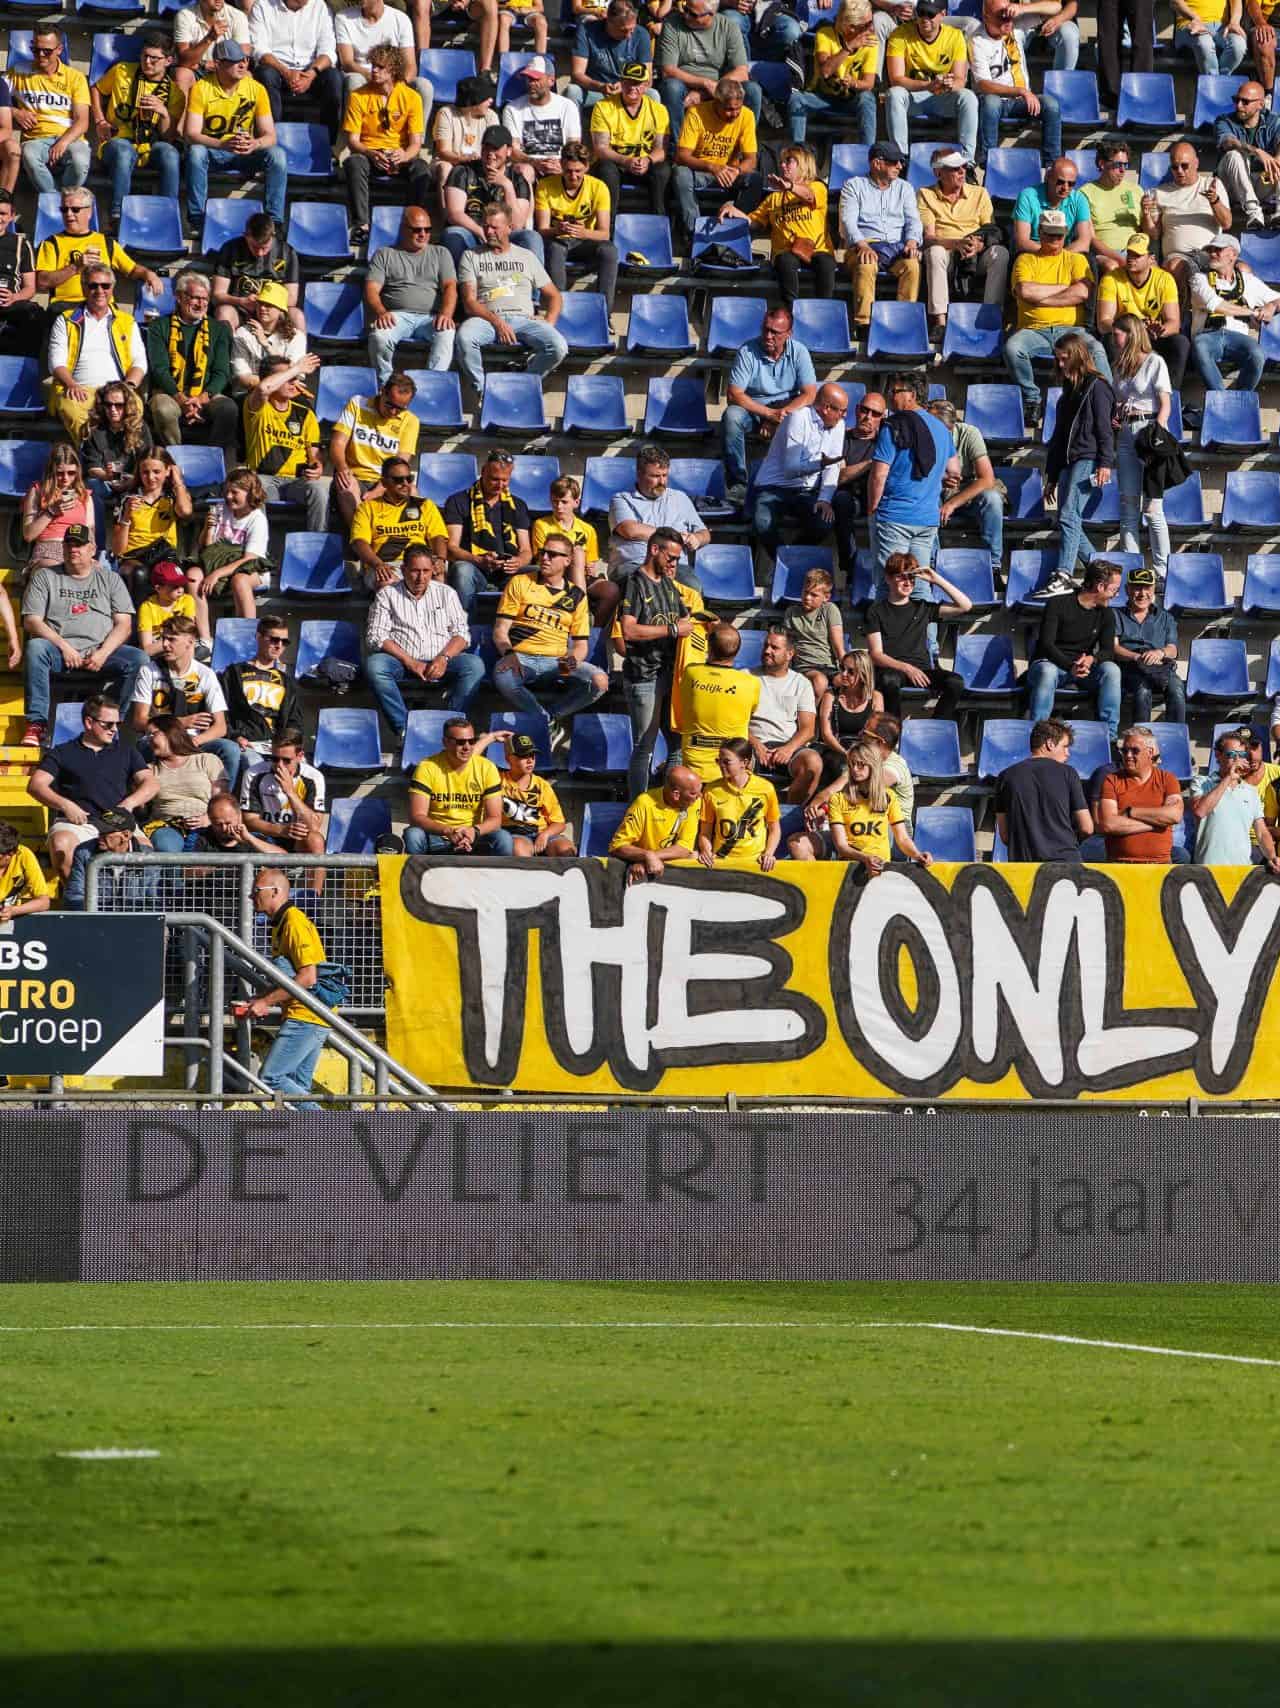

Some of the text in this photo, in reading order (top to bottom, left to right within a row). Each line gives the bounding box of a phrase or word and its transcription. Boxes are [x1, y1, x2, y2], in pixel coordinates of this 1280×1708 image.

[479, 261, 525, 273] BIG MOJITO
[376, 521, 426, 536] Sunweb
[690, 680, 724, 694] Vrolijk
[719, 819, 760, 839] OK
[849, 821, 883, 837] OK
[408, 860, 818, 1083] THE
[0, 979, 76, 1010] TRO
[0, 1011, 102, 1052] Groep
[127, 1120, 793, 1204] DE VLIERT
[887, 1176, 992, 1255] 34
[1016, 1154, 1193, 1262] jaar
